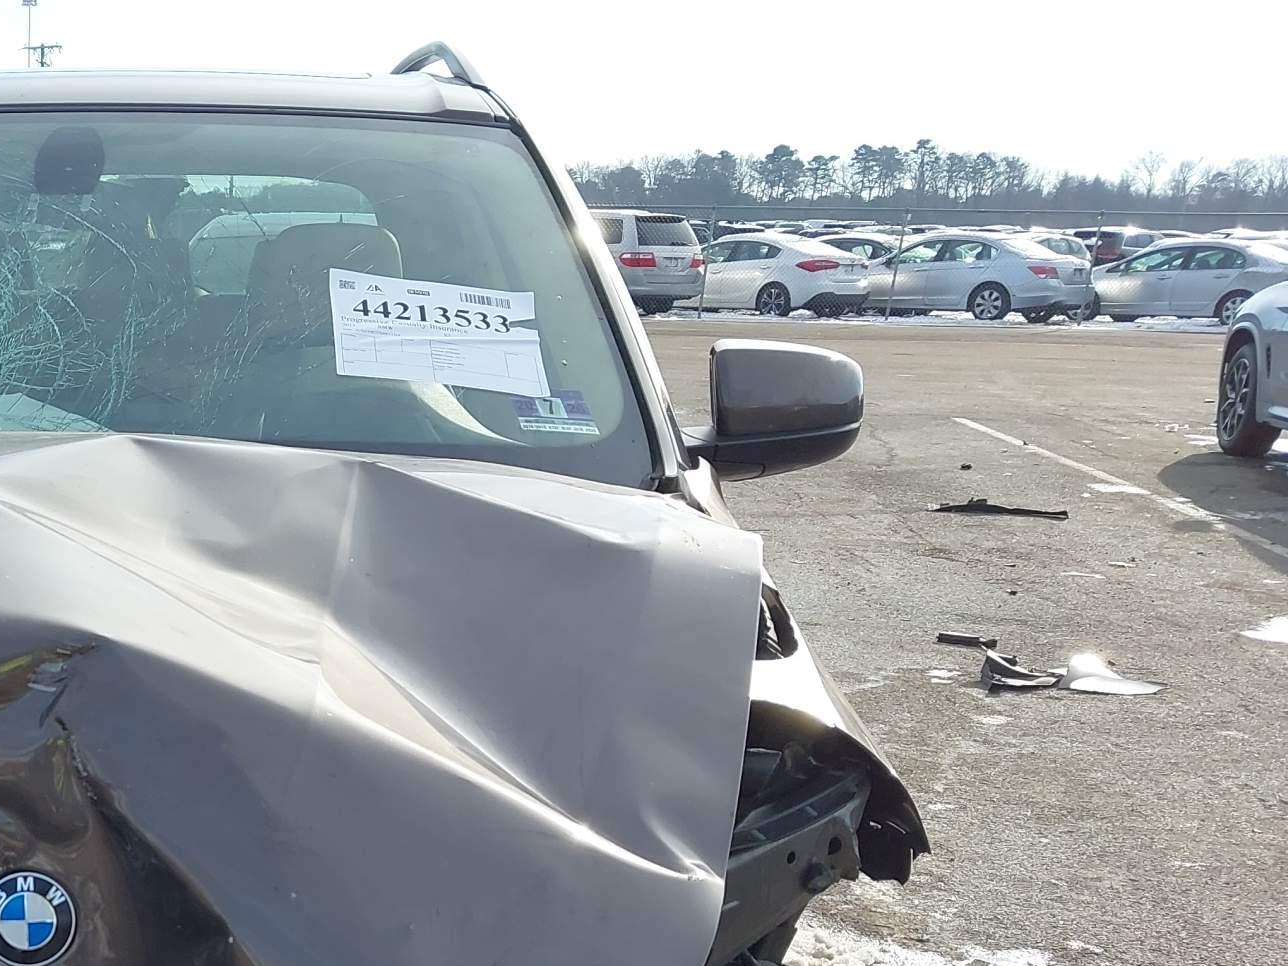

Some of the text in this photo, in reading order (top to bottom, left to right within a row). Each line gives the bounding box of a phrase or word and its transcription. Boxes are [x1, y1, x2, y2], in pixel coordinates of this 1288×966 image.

[340, 315, 389, 325] Progressive
[352, 299, 511, 334] 44213533
[543, 398, 554, 415] 7
